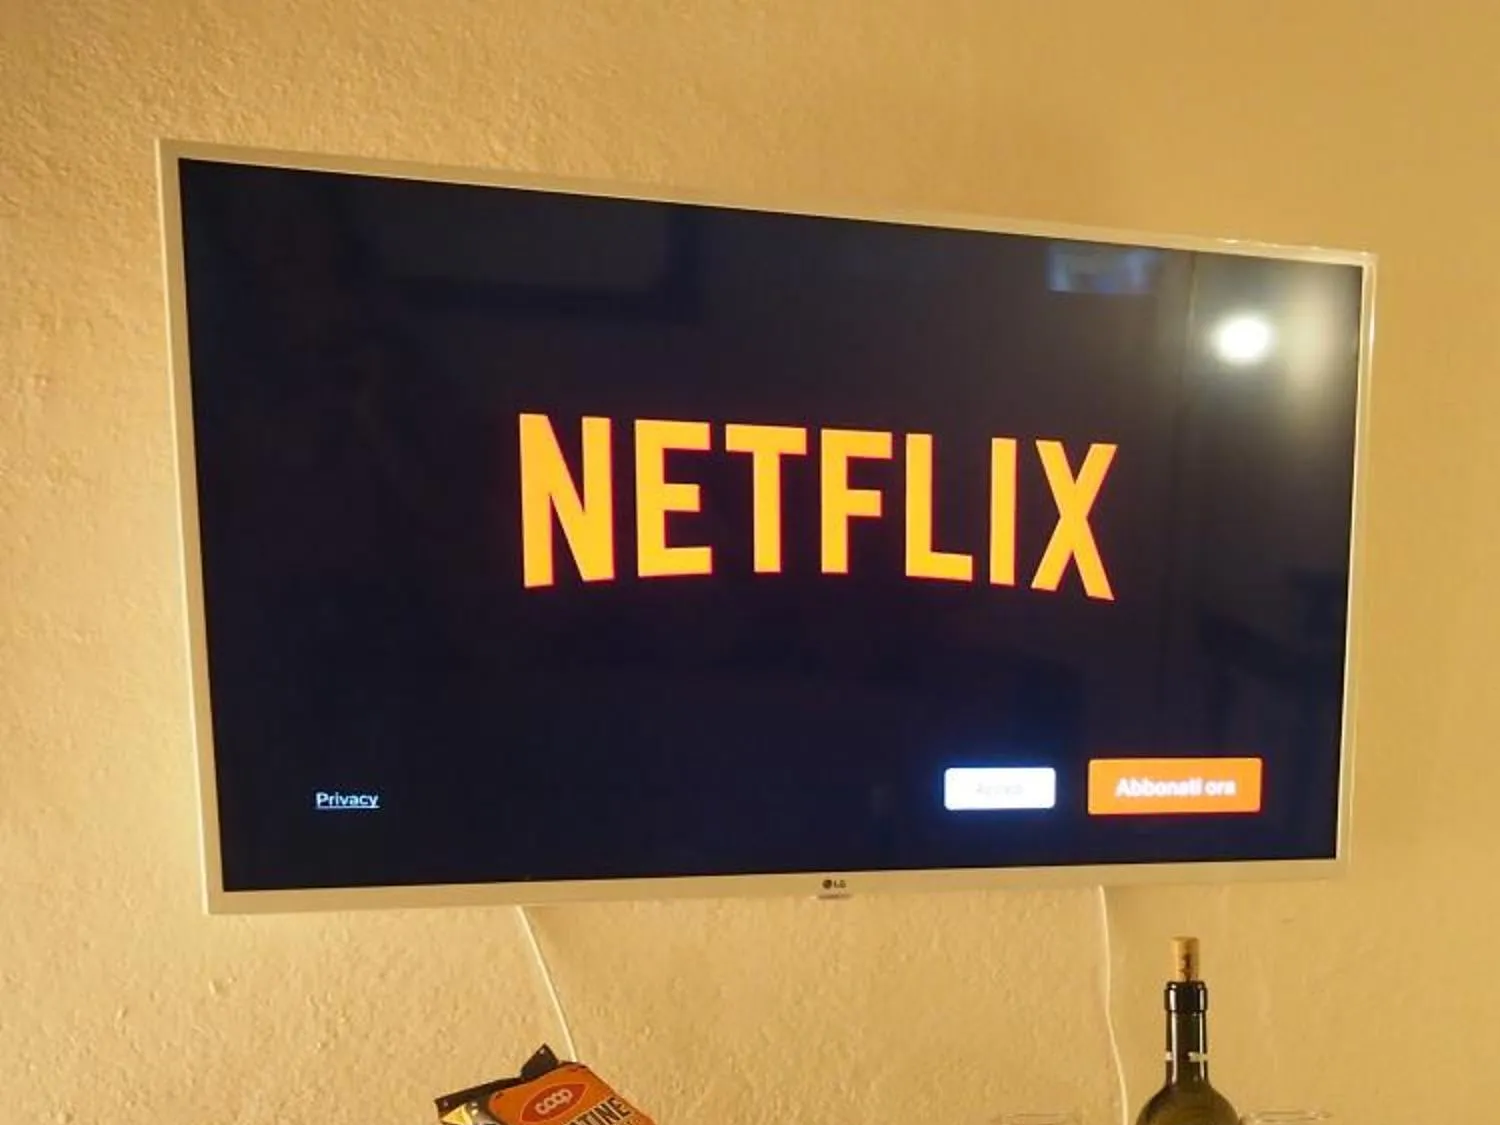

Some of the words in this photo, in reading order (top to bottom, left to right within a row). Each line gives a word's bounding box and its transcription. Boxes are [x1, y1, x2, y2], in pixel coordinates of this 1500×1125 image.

[519, 413, 1118, 601] NETFLIX
[1115, 778, 1201, 798] Abbonati
[1205, 781, 1236, 796] ora
[315, 791, 380, 809] Privacy
